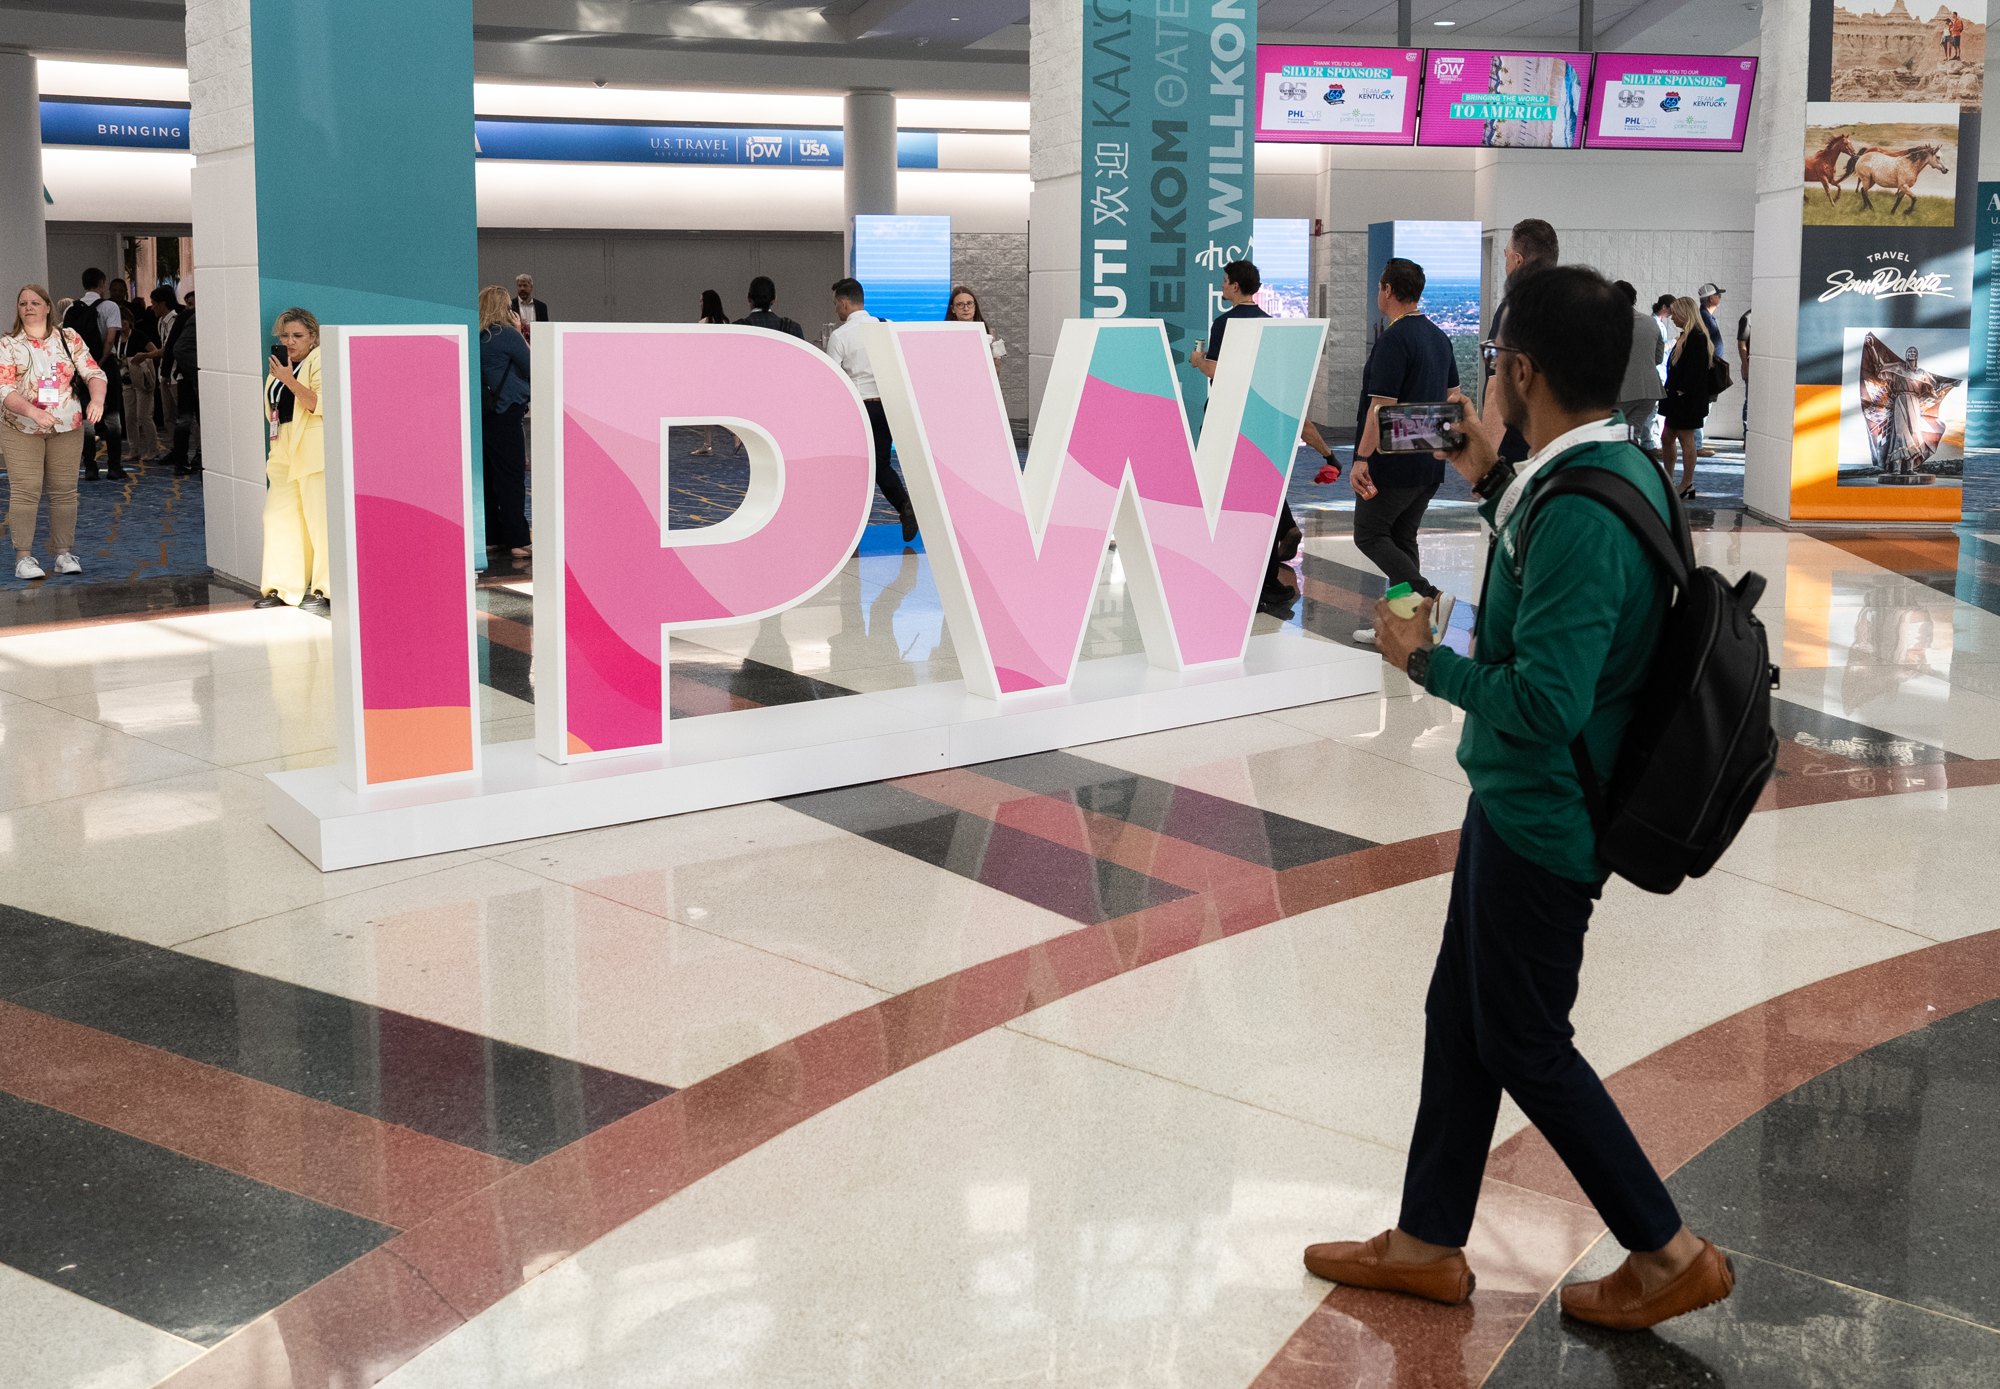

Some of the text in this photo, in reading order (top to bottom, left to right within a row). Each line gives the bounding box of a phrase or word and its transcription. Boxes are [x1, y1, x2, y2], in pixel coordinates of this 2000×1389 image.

[1282, 66, 1388, 78] SILVER SPONSORS
[1623, 75, 1723, 86] SILVER SPONSORS
[1329, 89, 1342, 99] 66
[1665, 97, 1676, 106] 66
[1454, 105, 1552, 119] TO AMERICA
[98, 124, 181, 137] BRINGING
[650, 138, 729, 150] U.S. TRAVEL
[800, 144, 830, 156] USA
[746, 140, 782, 162] ipw
[1090, 142, 1129, 226] 欢迎
[1867, 251, 1910, 262] TRAVEL
[320, 317, 1328, 794] IPW
